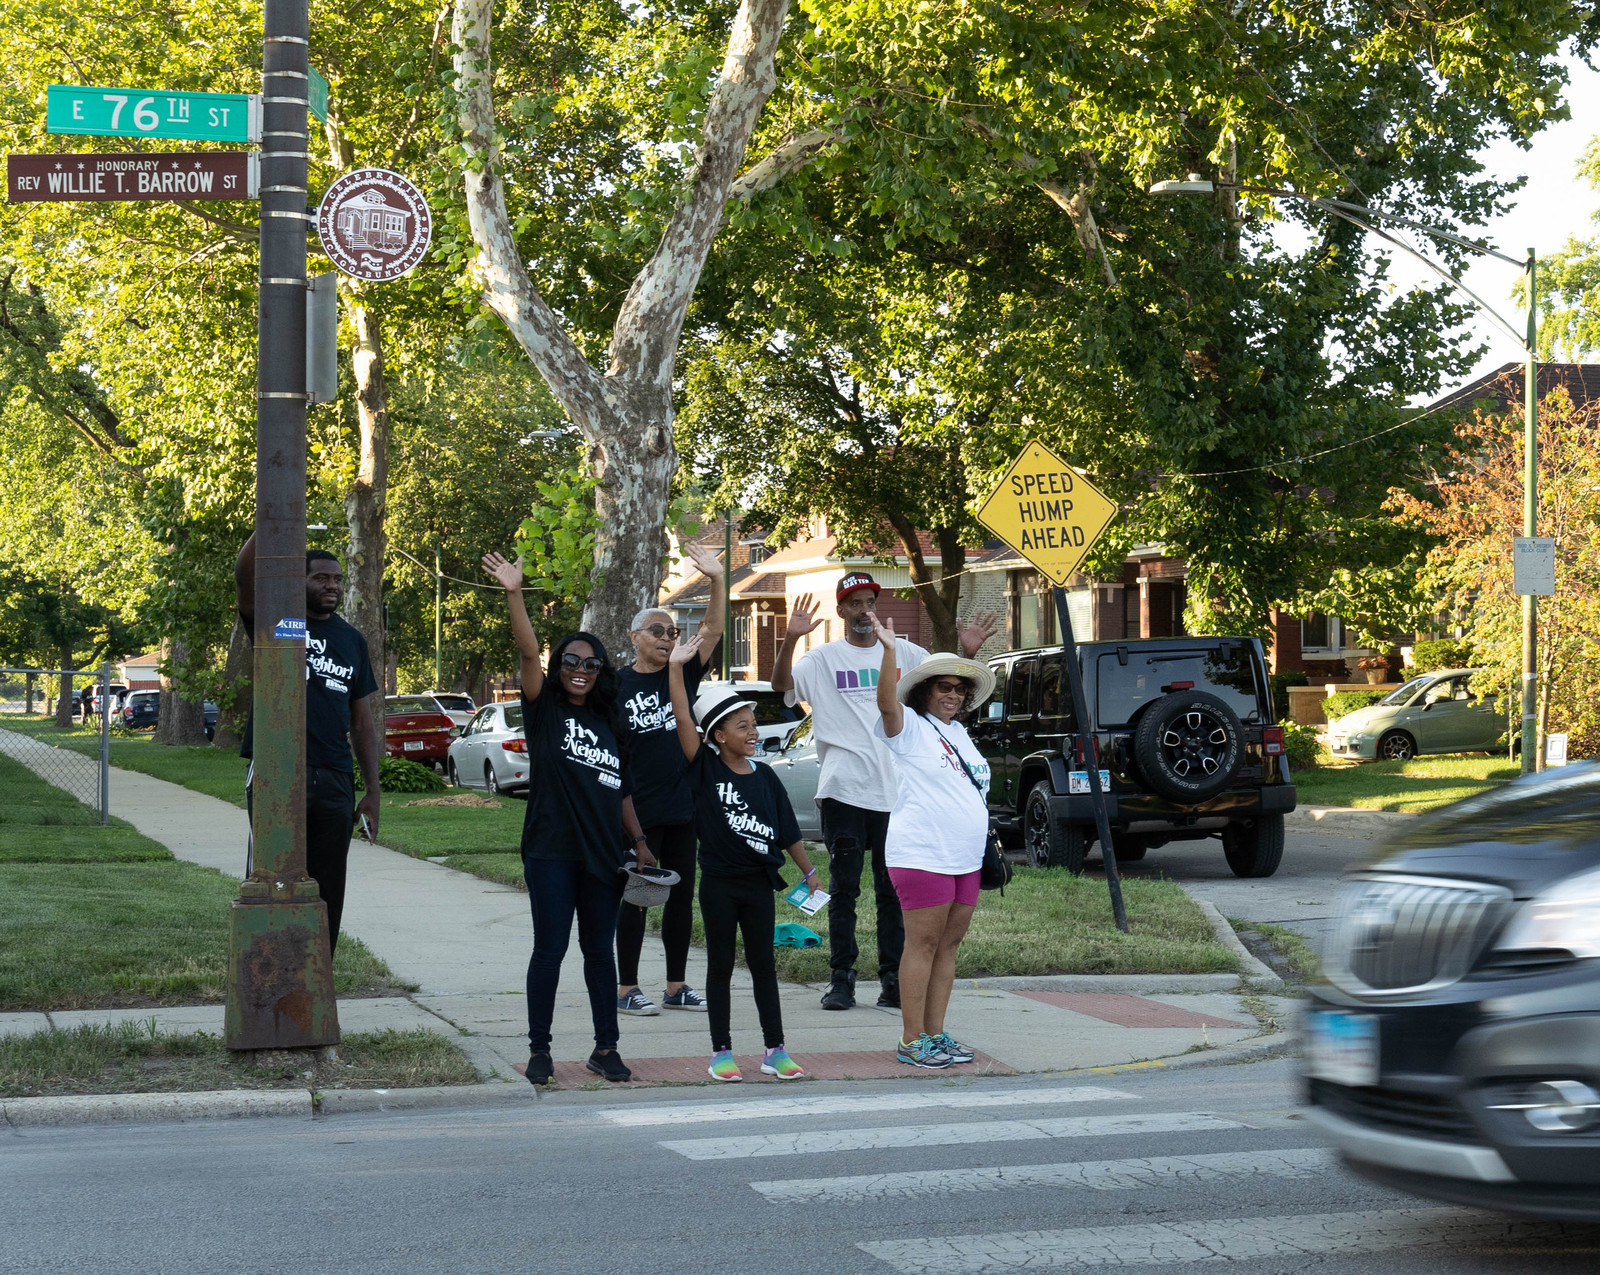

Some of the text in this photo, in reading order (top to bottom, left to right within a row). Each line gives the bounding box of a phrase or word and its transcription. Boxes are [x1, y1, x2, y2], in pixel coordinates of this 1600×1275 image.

[73, 100, 84, 120] E
[208, 108, 230, 128] ST
[97, 160, 159, 171] HONORARY
[17, 171, 238, 194] REV WILLIE T. BARROW ST
[328, 171, 425, 211] CELEBRATING
[320, 216, 429, 278] CHICAGO BUNGALOWS
[1011, 472, 1074, 496] SPEED
[1018, 499, 1074, 523] HUMP
[1021, 525, 1085, 551] AHEAD
[306, 651, 354, 680] ighbor!
[625, 691, 660, 716] Hey
[564, 718, 599, 746] Hy
[723, 806, 775, 840] ighbor!
